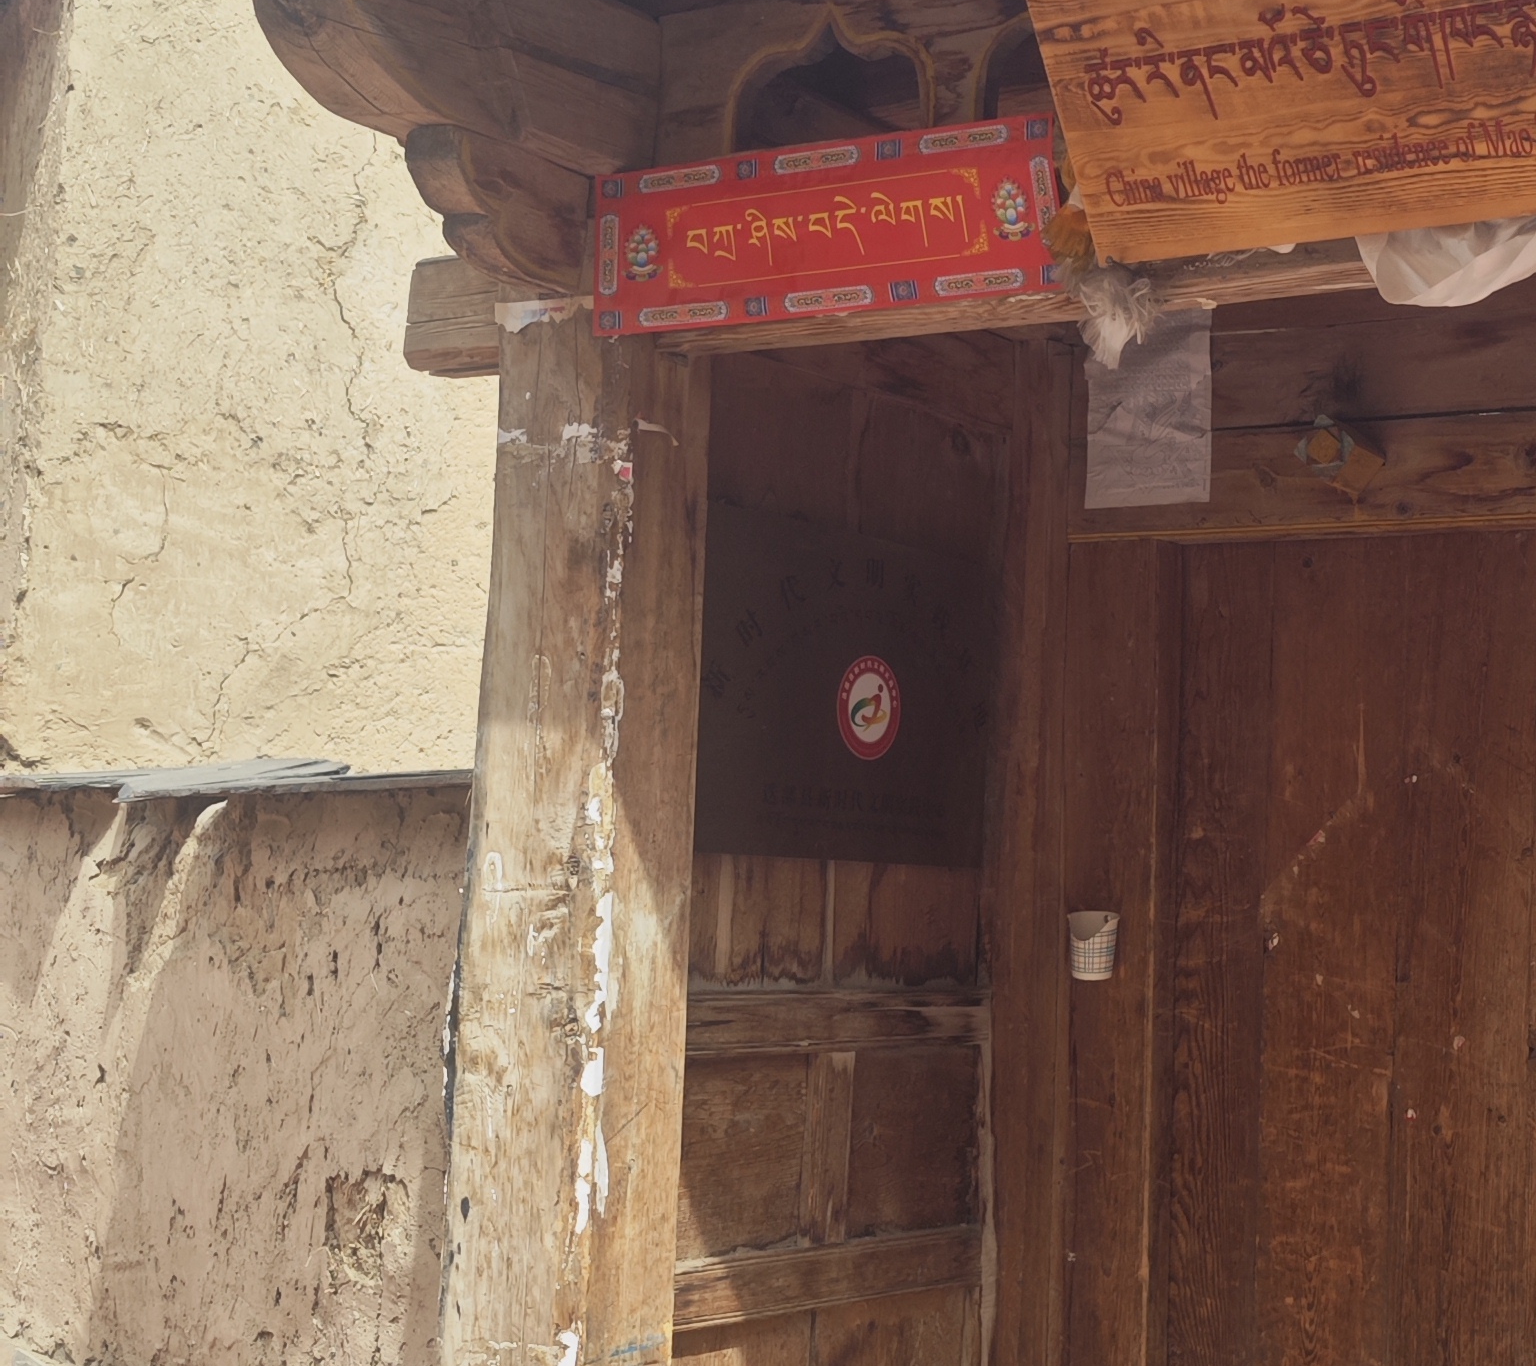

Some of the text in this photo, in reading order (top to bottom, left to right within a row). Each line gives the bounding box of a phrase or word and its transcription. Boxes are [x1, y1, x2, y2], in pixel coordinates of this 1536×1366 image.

[1104, 169, 1163, 208] China
[1167, 163, 1236, 204] village
[1237, 152, 1271, 191] the
[1271, 147, 1342, 188] former
[1352, 132, 1451, 176] residence
[1455, 124, 1484, 162] of
[1482, 117, 1534, 157] Mao
